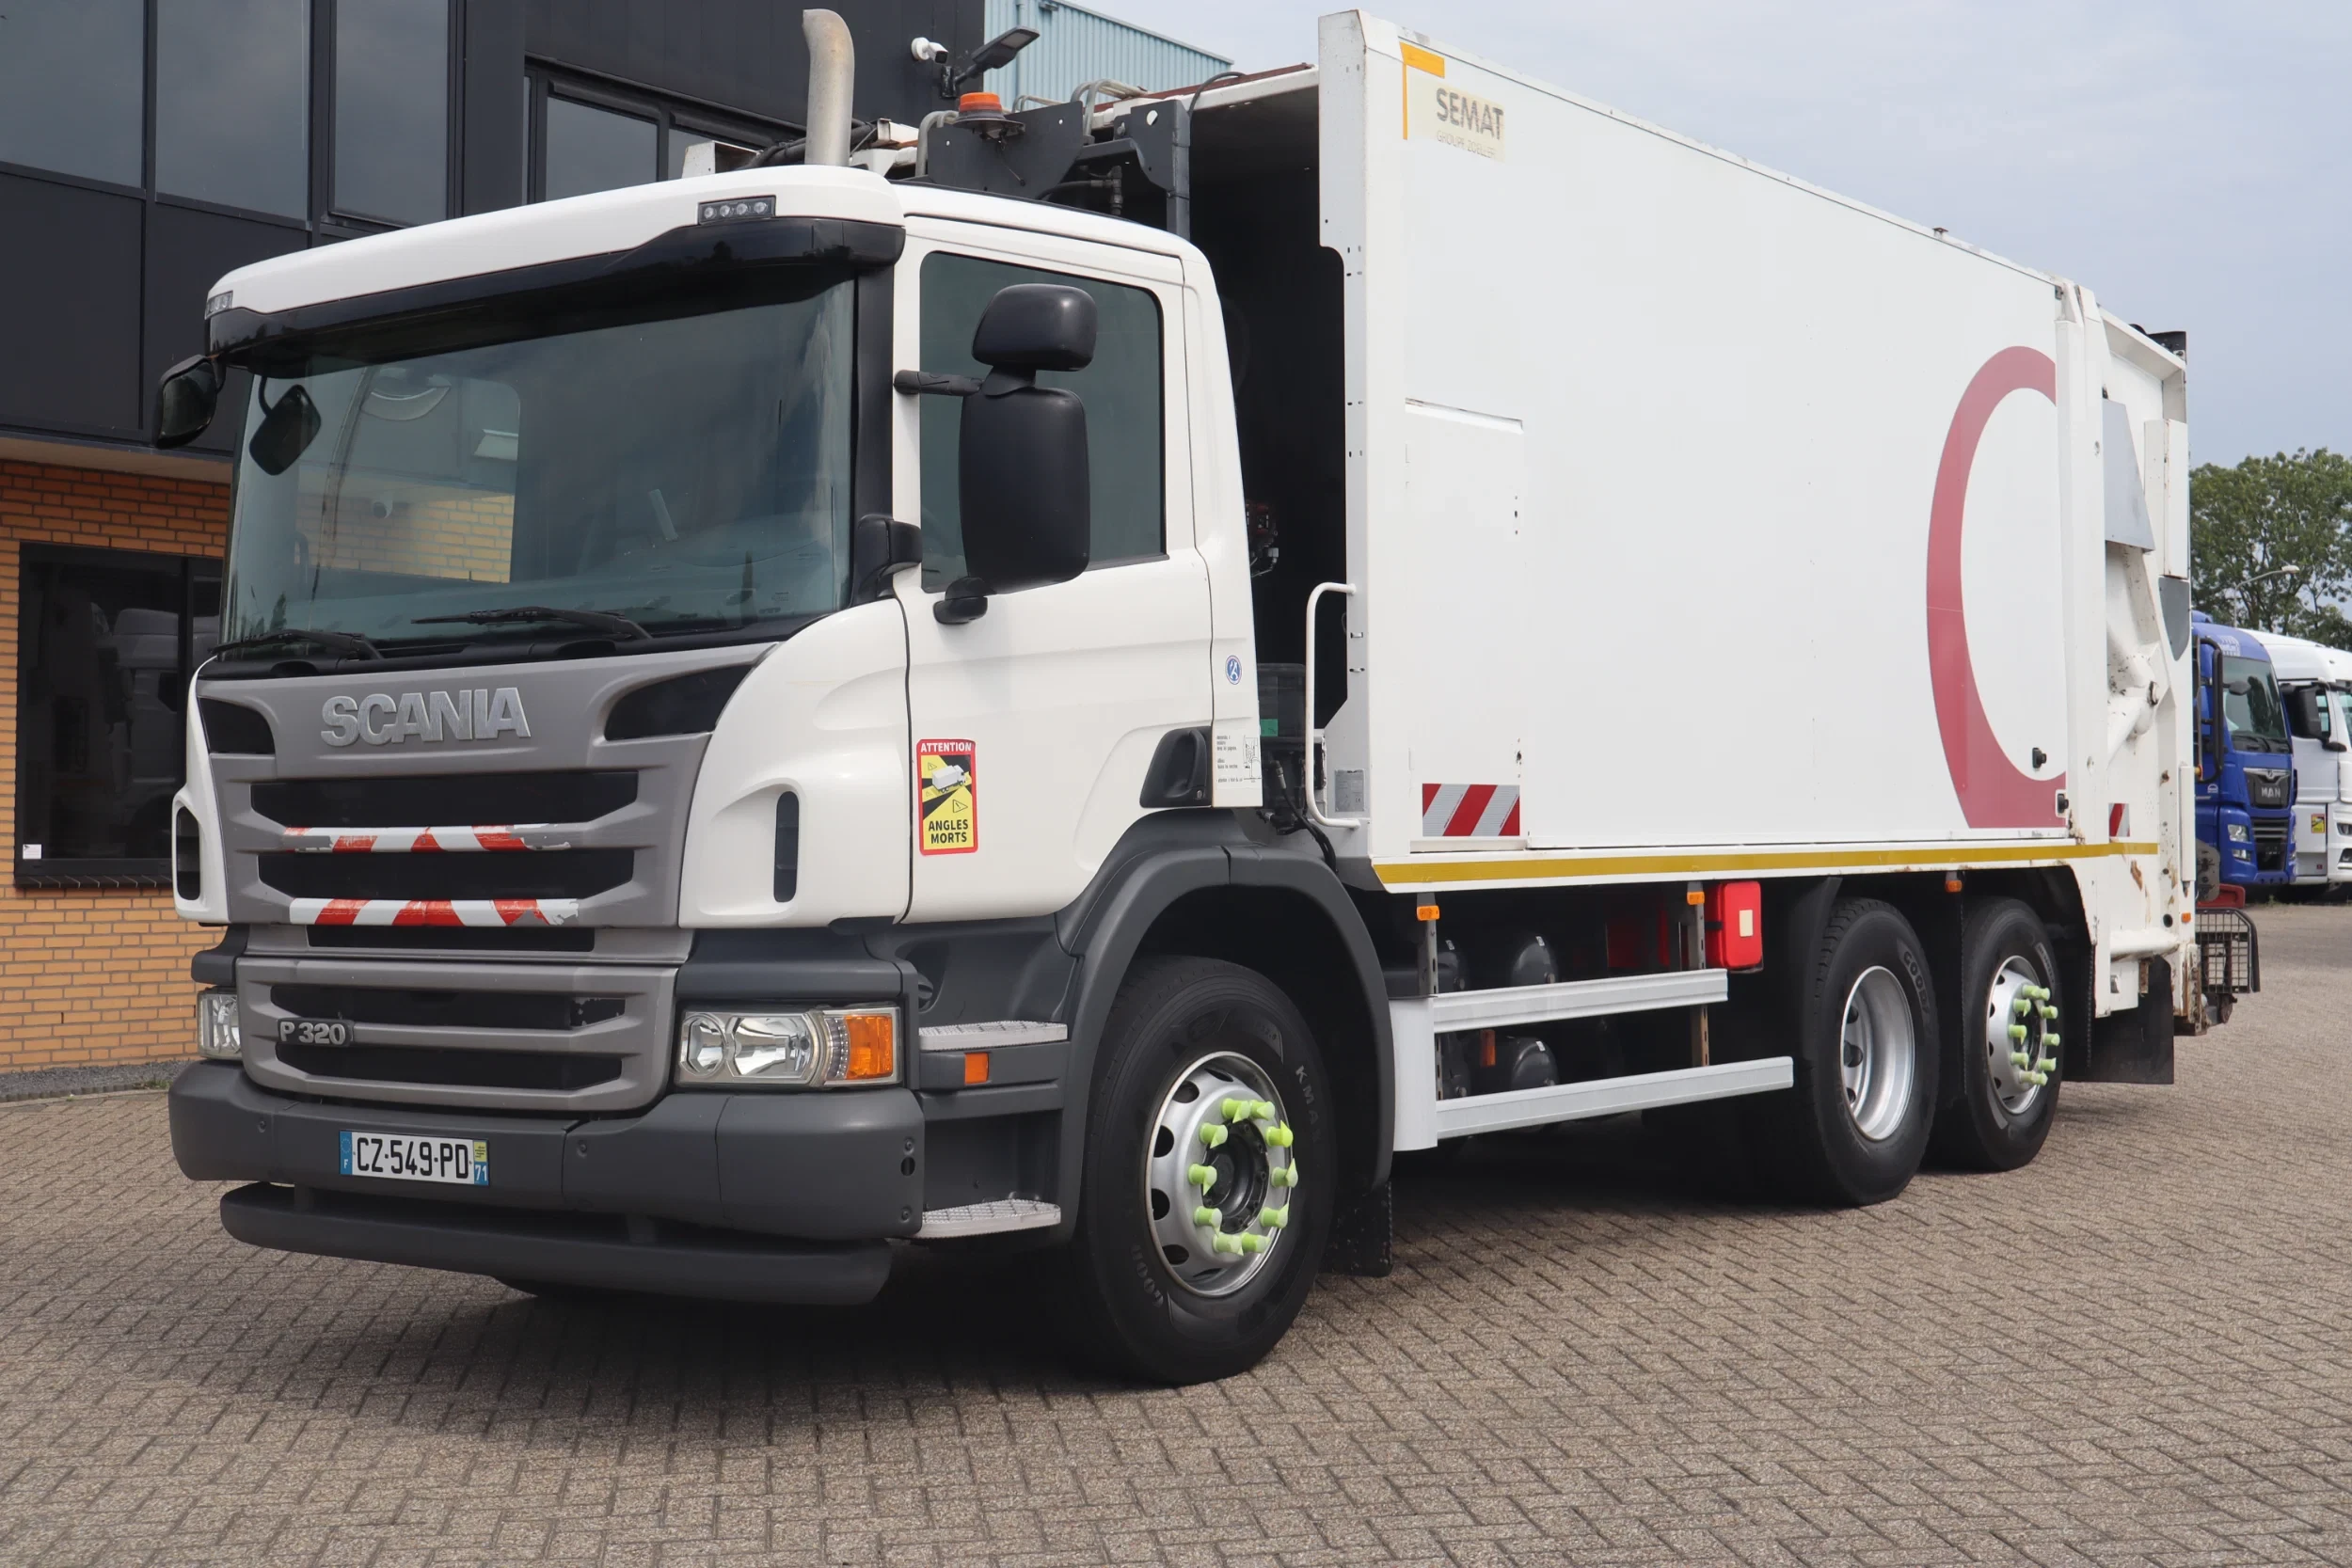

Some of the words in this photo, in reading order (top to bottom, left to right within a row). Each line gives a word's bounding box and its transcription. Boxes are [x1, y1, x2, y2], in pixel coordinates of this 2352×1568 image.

[1436, 87, 1504, 140] SEMAT
[321, 688, 532, 747] SCANIA
[921, 742, 972, 752] ATTENTION
[2261, 787, 2280, 798] MAN
[929, 819, 969, 832] ANGLES
[930, 832, 968, 844] MORTS
[280, 1022, 295, 1041] P
[298, 1022, 346, 1045] 320
[343, 1159, 349, 1169] F
[474, 1164, 487, 1182] 71
